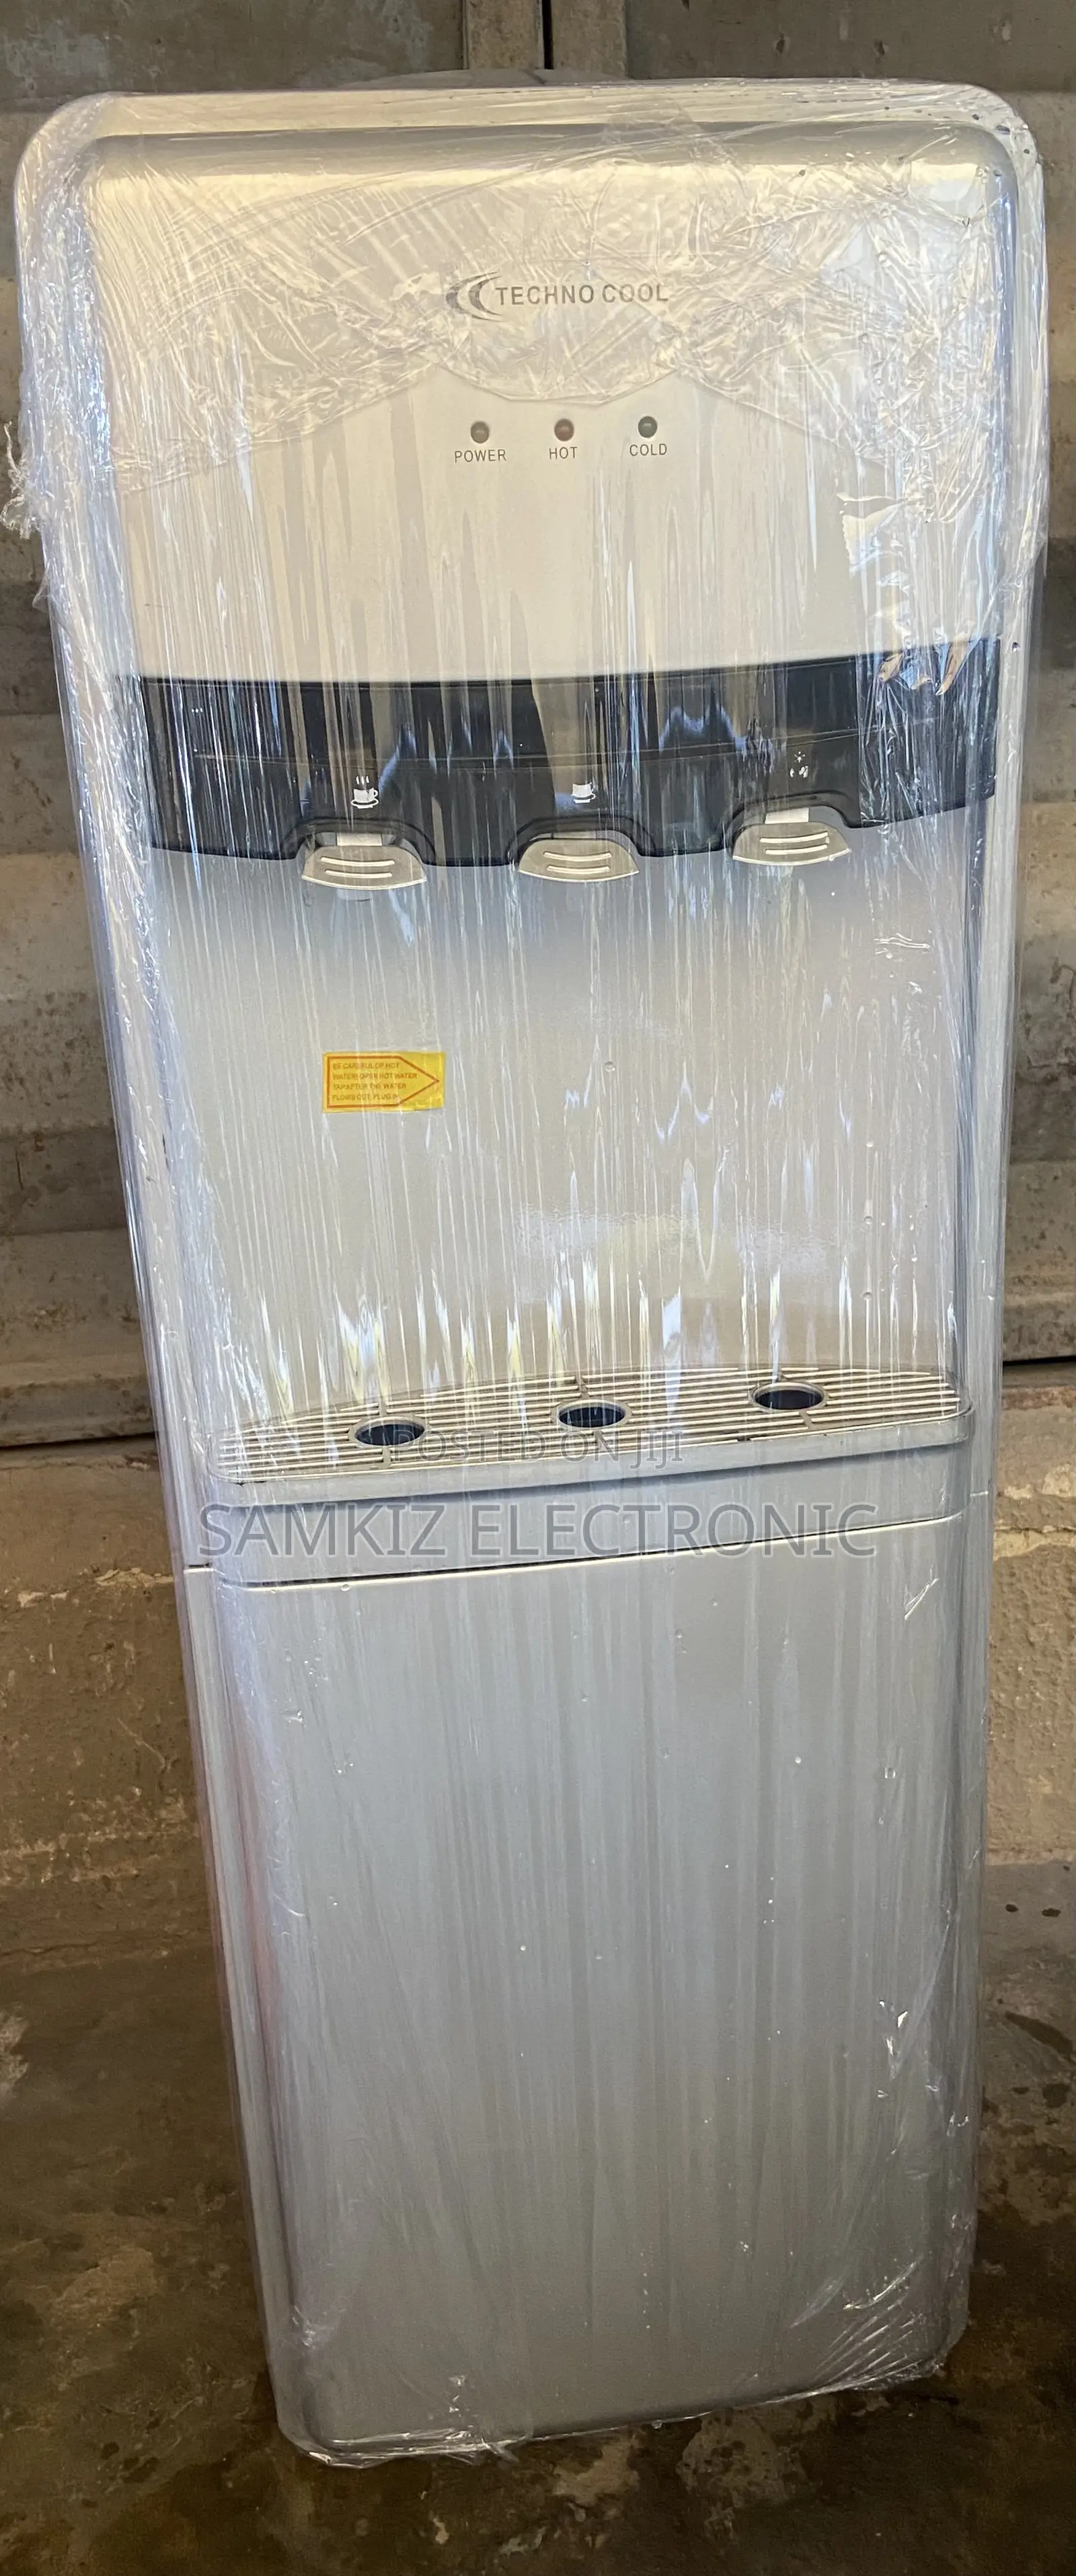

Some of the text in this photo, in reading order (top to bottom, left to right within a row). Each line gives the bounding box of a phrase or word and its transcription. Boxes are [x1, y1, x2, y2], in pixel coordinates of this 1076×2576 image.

[496, 283, 668, 305] TECHNO COOL
[455, 449, 507, 463] POWER
[549, 447, 578, 459] HOT
[629, 443, 667, 457] COLD
